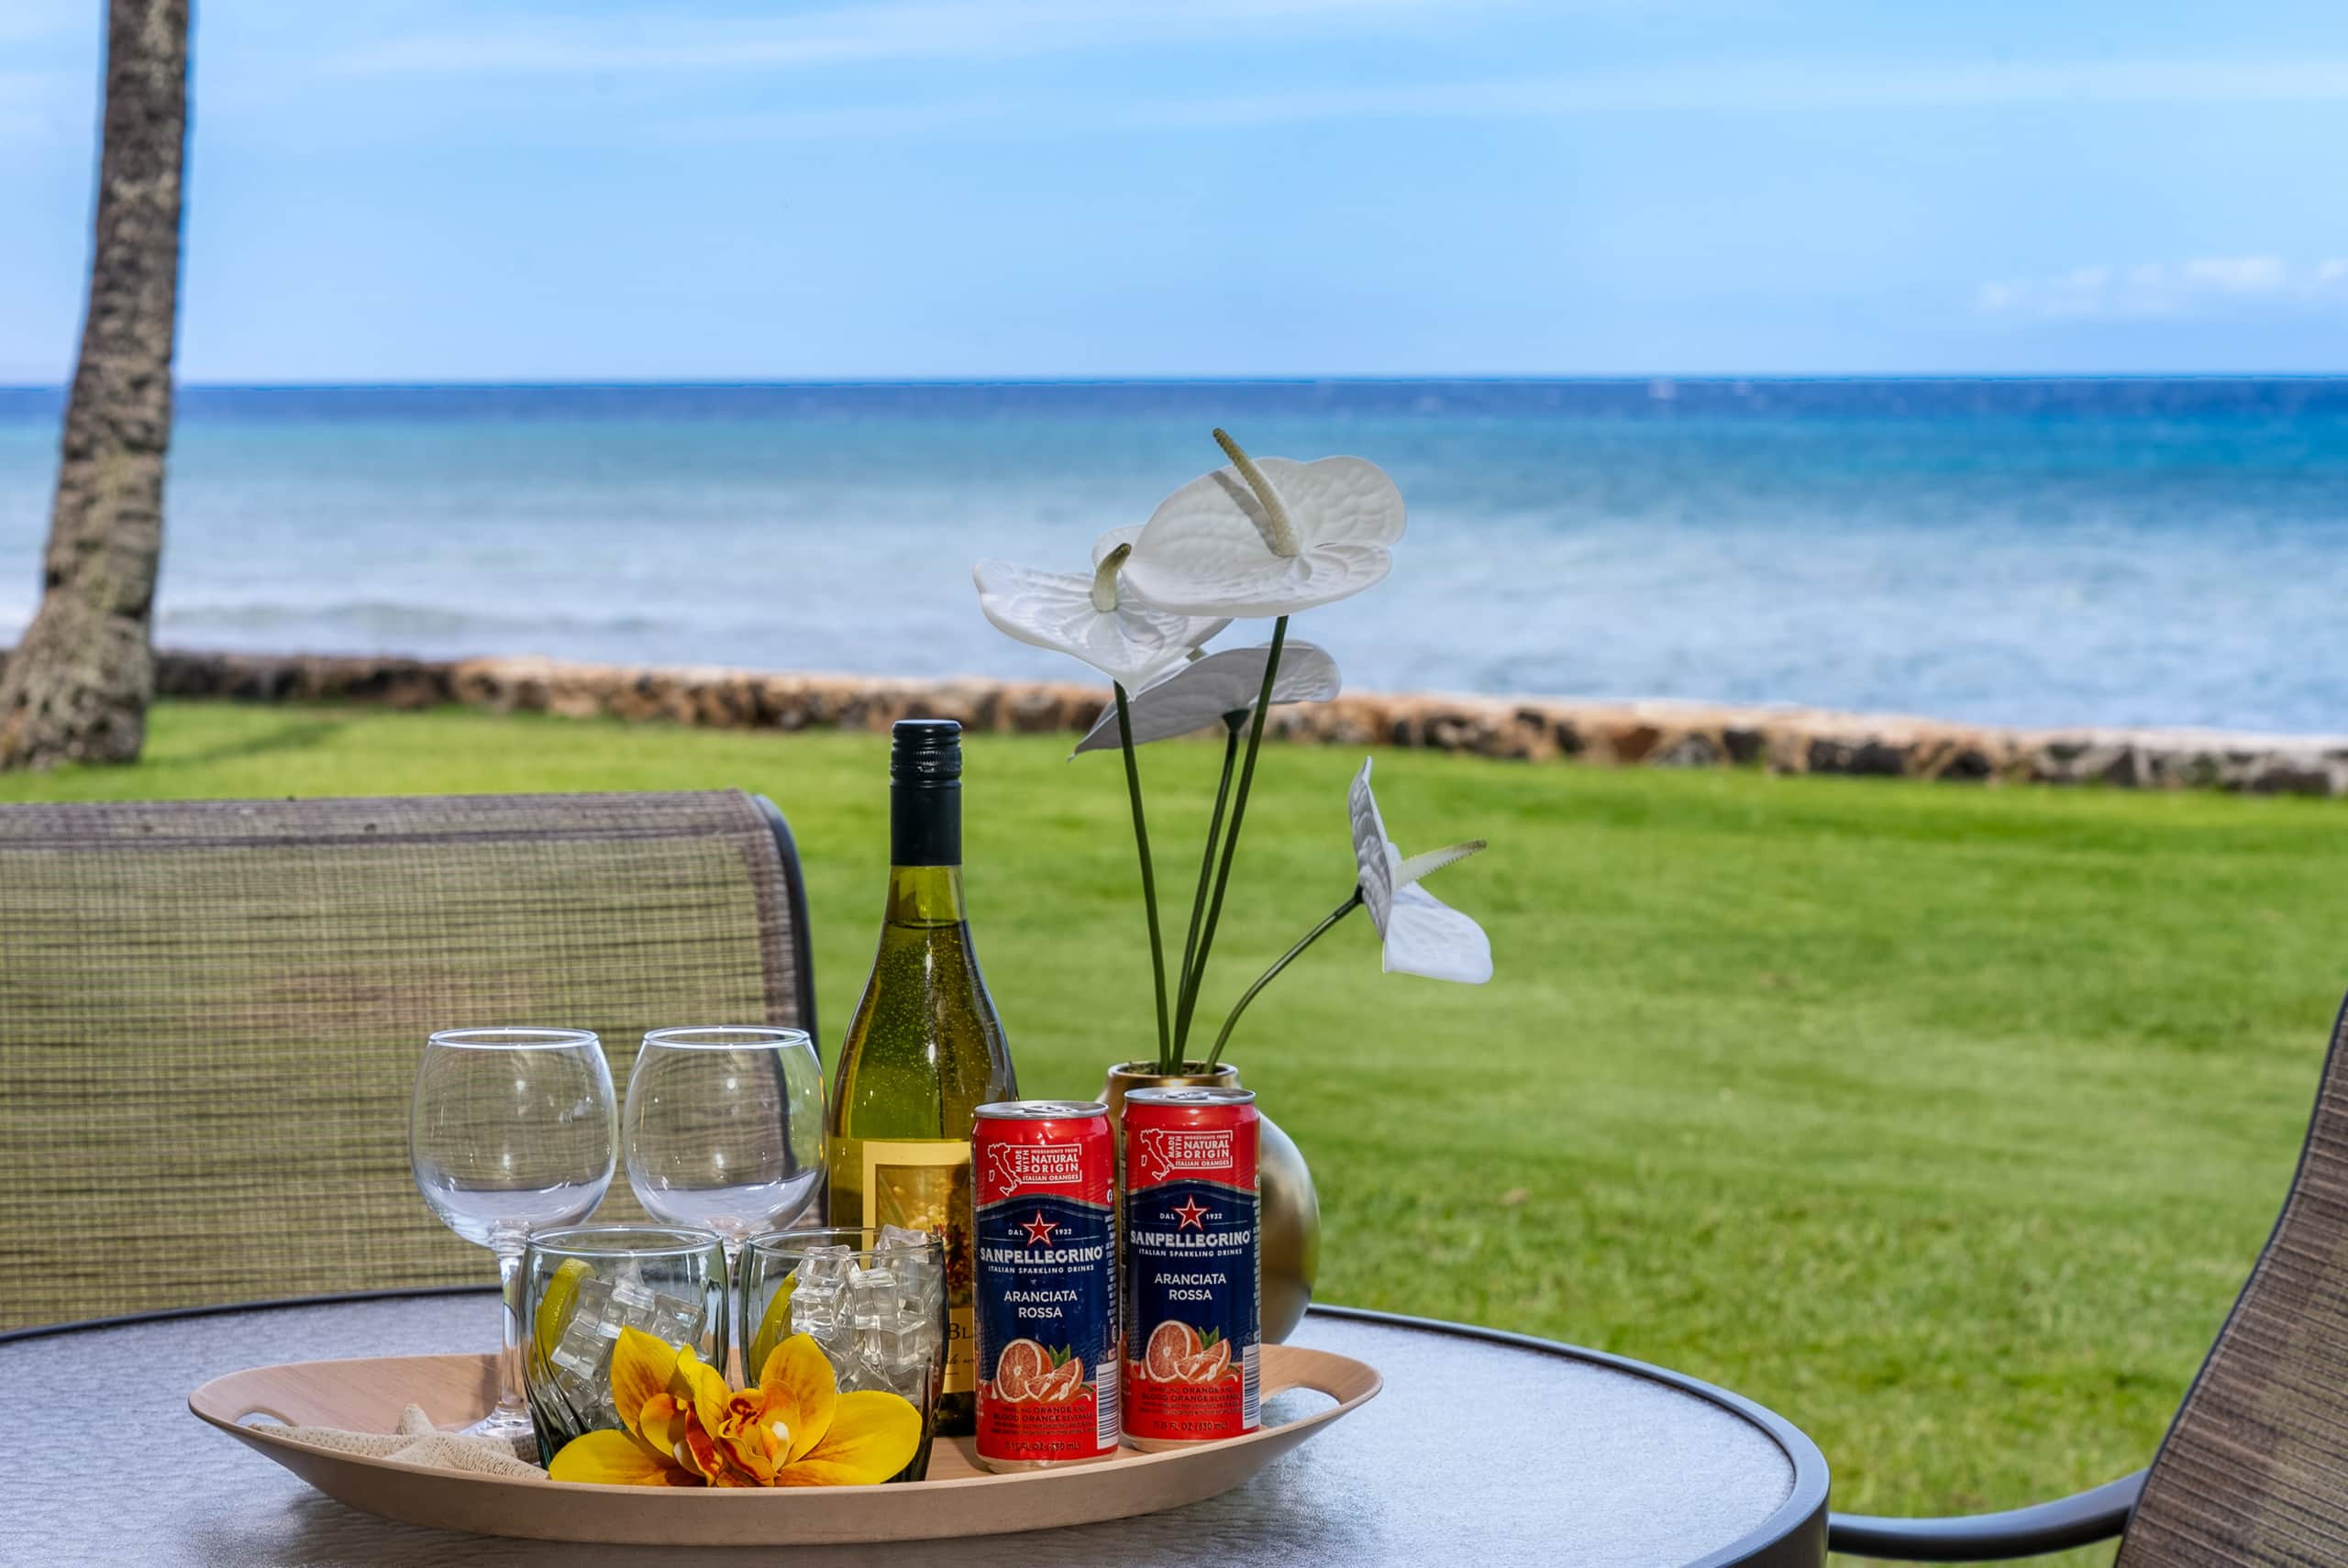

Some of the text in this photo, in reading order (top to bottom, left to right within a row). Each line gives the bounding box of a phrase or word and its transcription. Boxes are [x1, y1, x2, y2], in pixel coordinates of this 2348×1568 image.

[1184, 1140, 1229, 1150] NATURAL
[1031, 1154, 1079, 1164] NATURAL
[1184, 1150, 1229, 1159] ORIGIN
[1031, 1164, 1079, 1173] ORIGIN
[1130, 1230, 1250, 1247] SANPELLEGRINO
[980, 1246, 1102, 1264] SANPELLEGRINO
[1139, 1248, 1166, 1256] ITALIAN
[1217, 1248, 1242, 1256] DRINKS
[989, 1265, 1015, 1274] ITALIAN
[1068, 1264, 1094, 1273] DRINKS
[1154, 1273, 1226, 1285] ARANCIATA
[1003, 1290, 1078, 1302] ARANCIATA
[1168, 1289, 1213, 1300] ROSSA
[1018, 1307, 1063, 1319] ROSSA
[1170, 1394, 1209, 1402] ORANGE
